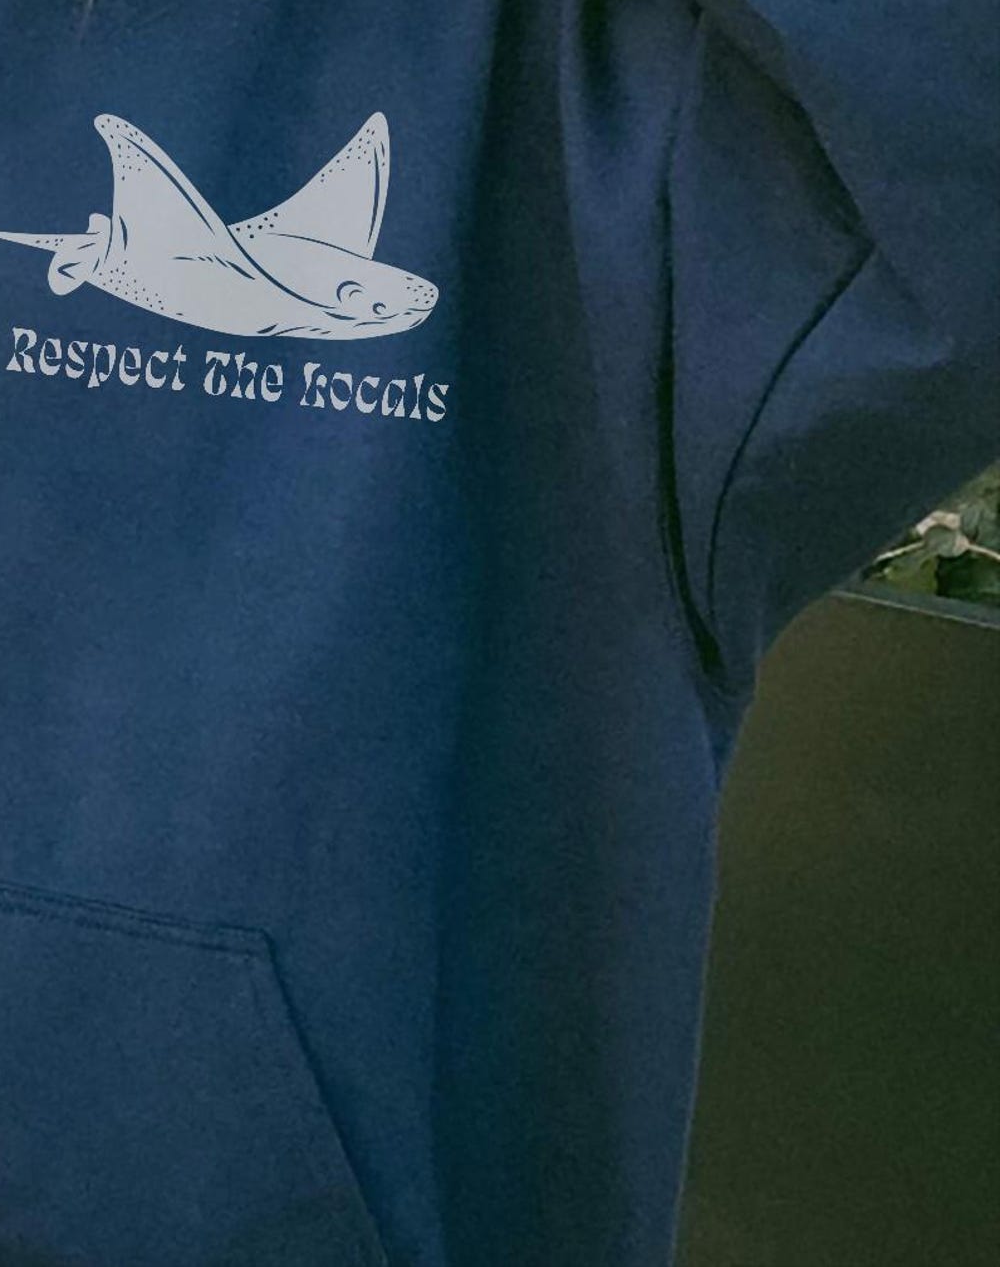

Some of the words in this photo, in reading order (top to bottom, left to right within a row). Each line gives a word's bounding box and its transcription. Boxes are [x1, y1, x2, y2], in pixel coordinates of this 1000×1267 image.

[6, 327, 187, 391] Respect
[203, 350, 284, 402] The
[299, 361, 450, 423] Locals
